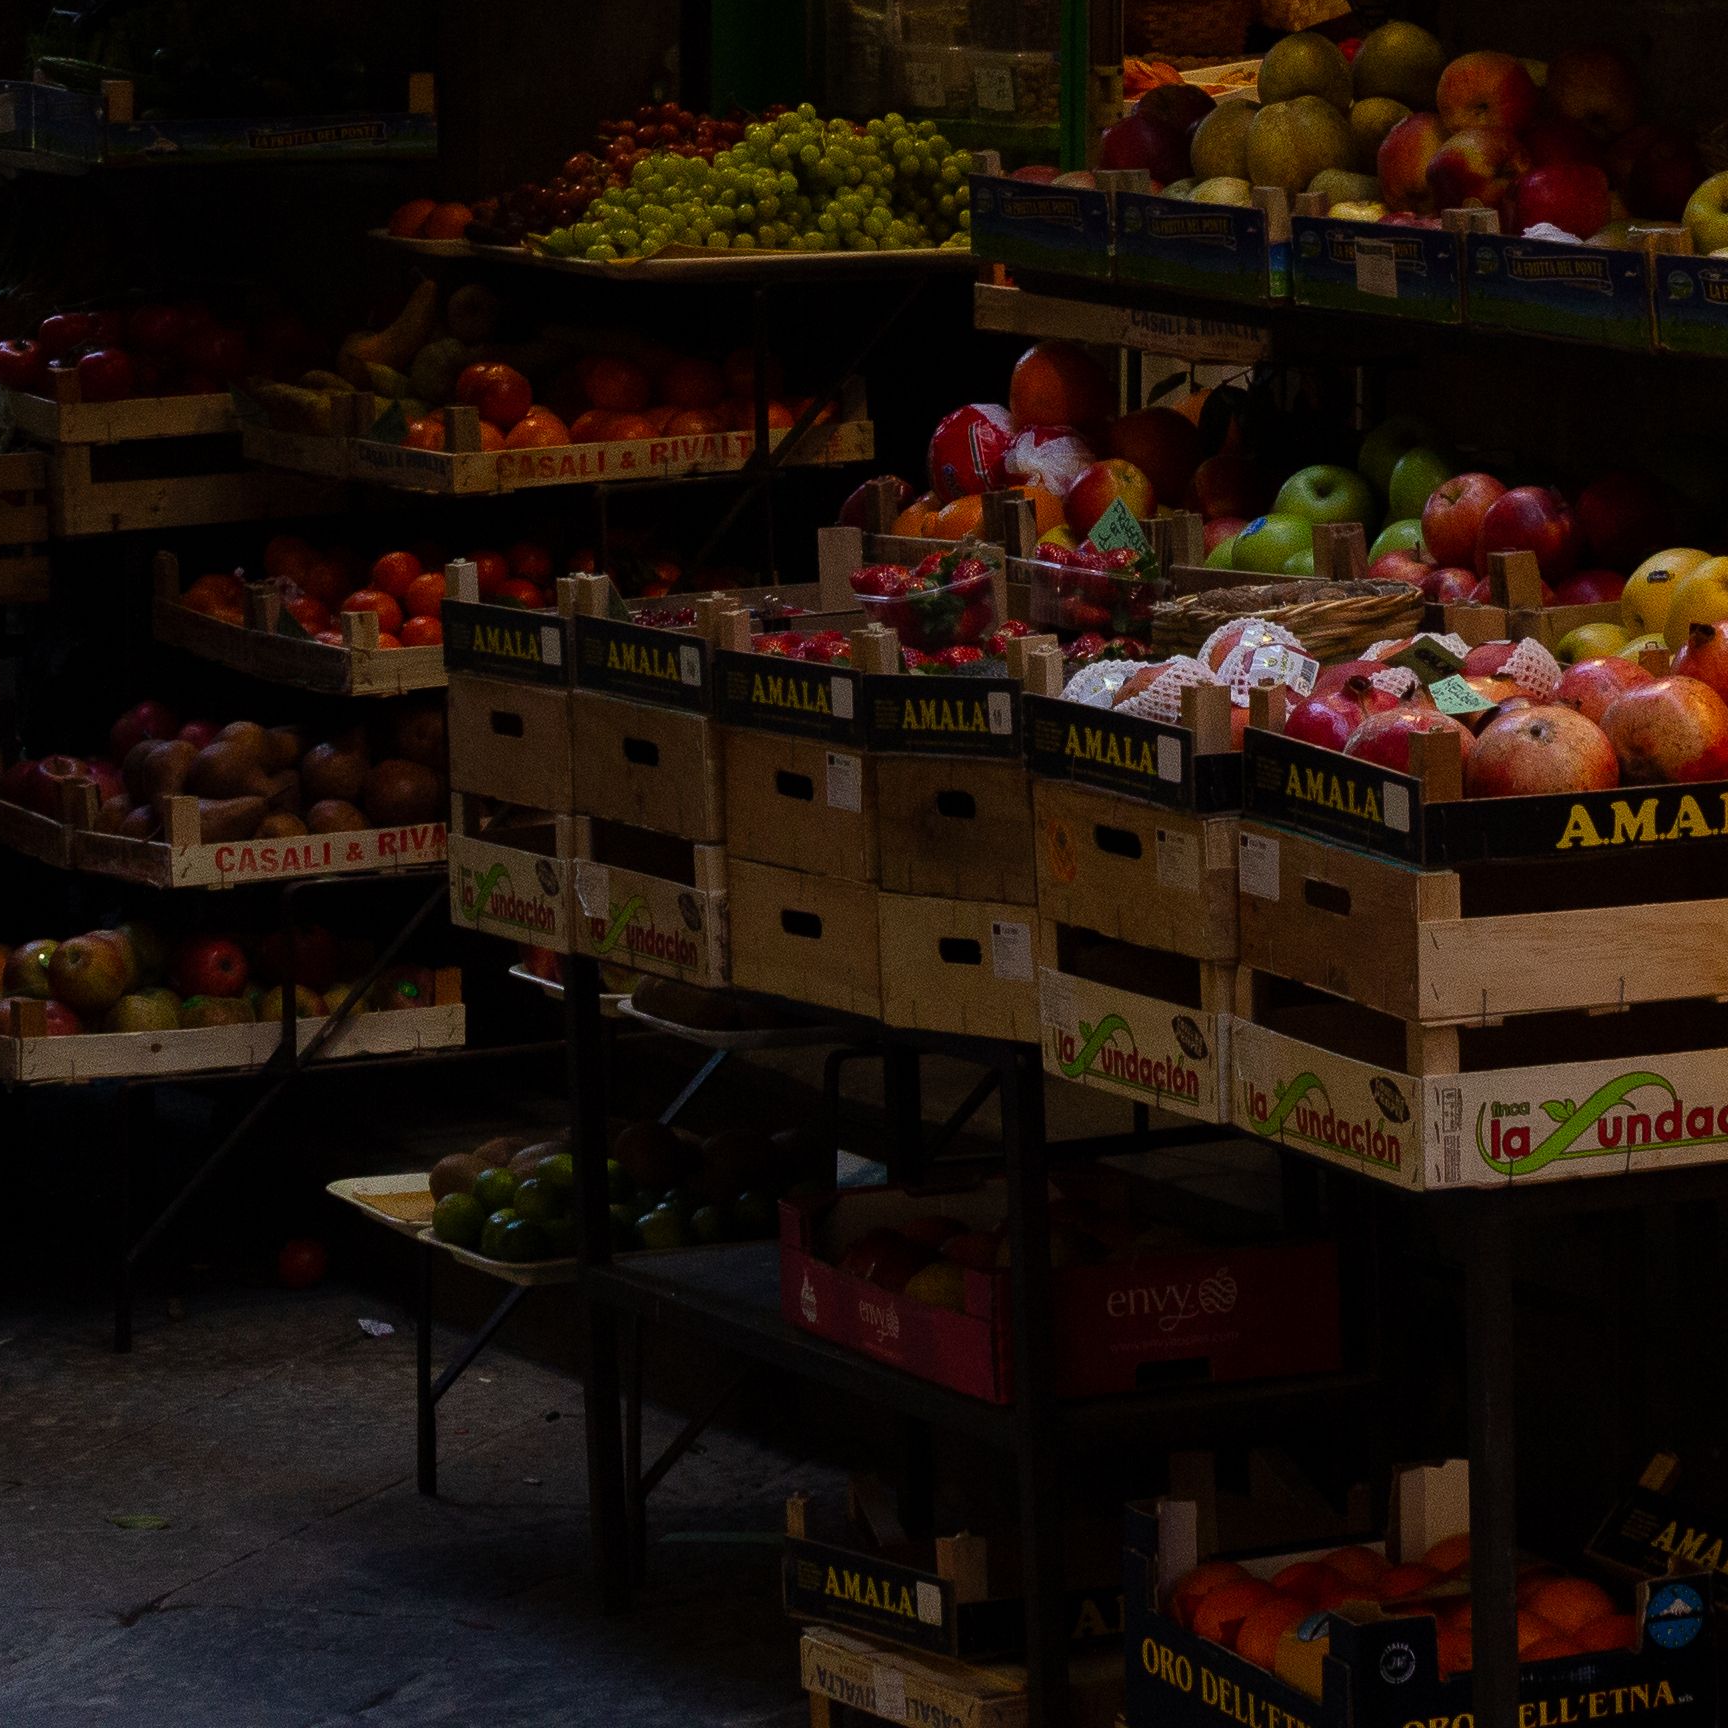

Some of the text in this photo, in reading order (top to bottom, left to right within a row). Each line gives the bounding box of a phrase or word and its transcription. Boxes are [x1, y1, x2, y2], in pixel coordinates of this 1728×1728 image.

[495, 434, 753, 480] CASALI & RIVALT
[214, 822, 448, 874] CASALI & RIVA
[1491, 1099, 1531, 1118] finca
[1489, 1118, 1532, 1160] la
[1106, 1279, 1200, 1333] envy
[1140, 1637, 1194, 1694] ORO
[1517, 1678, 1678, 1728] ELL'ETNA
